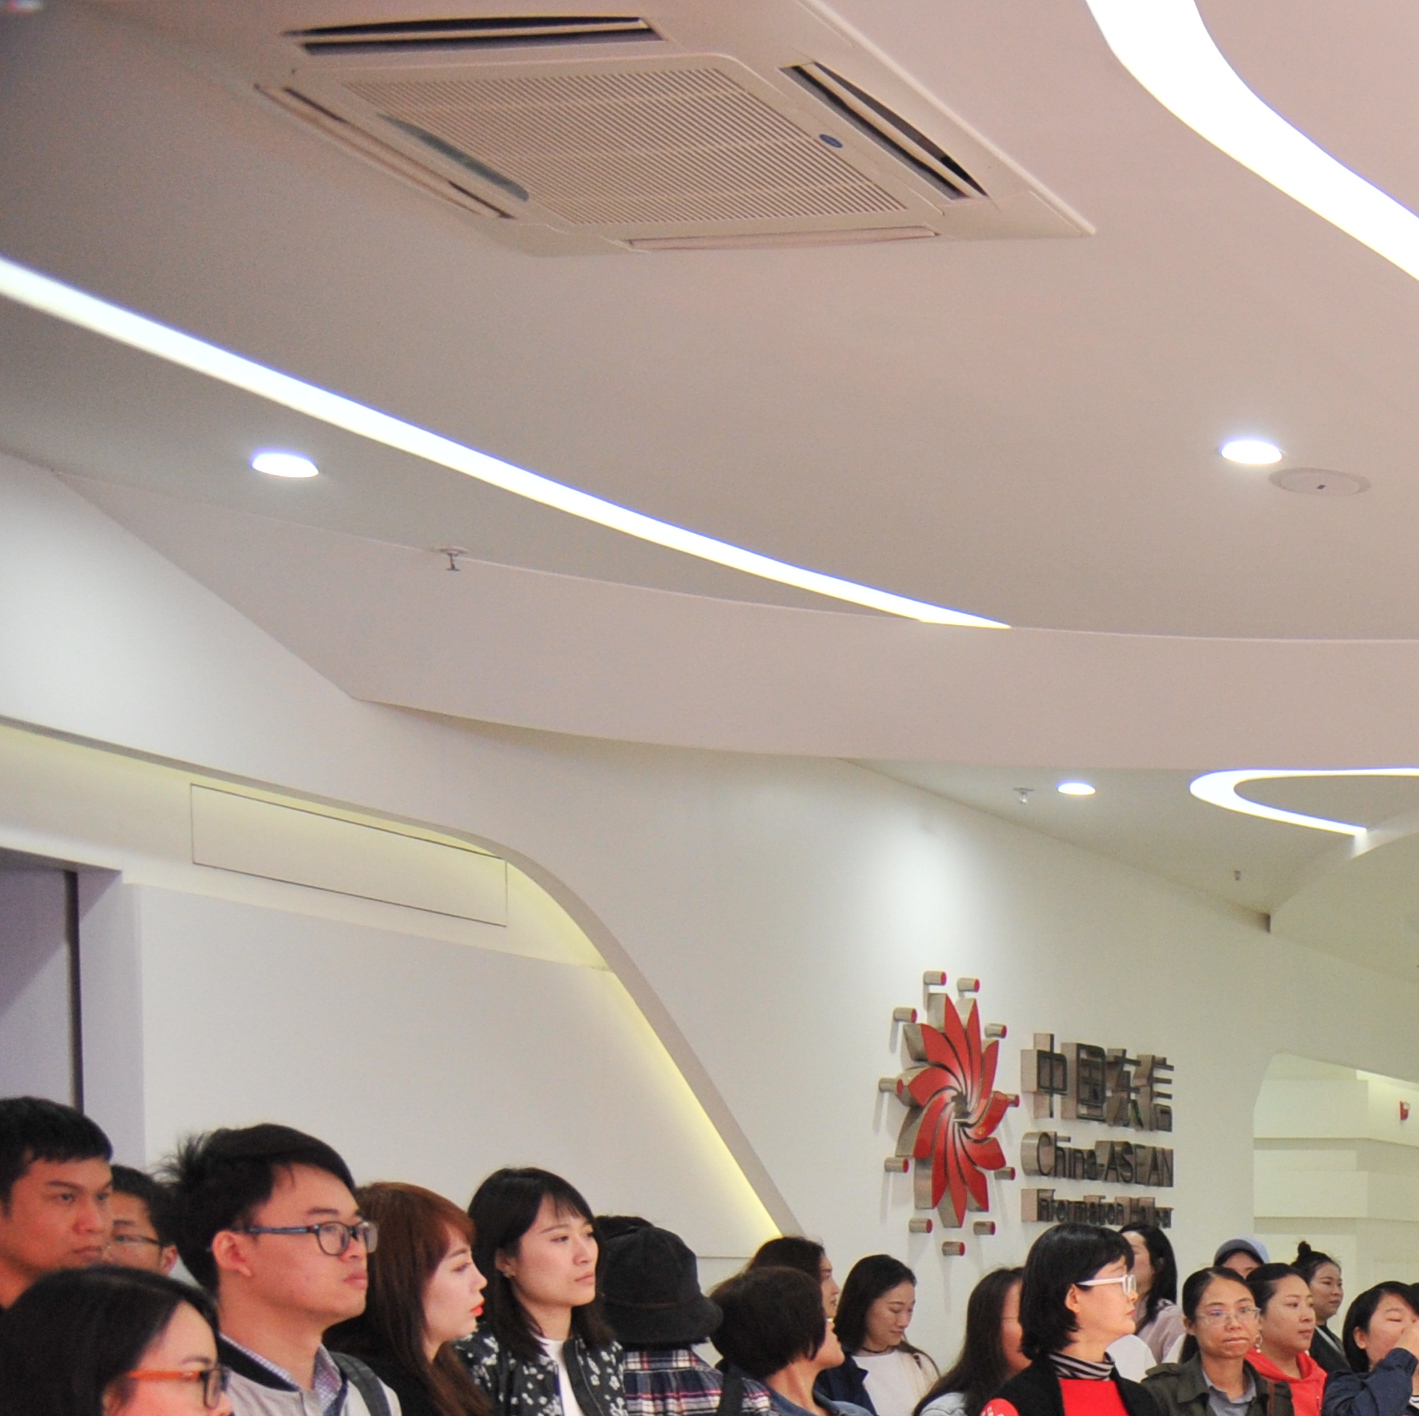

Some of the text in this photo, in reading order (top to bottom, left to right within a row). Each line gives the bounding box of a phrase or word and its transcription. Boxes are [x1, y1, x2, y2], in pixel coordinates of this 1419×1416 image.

[1022, 1033, 1175, 1132] 中国东信
[1021, 1131, 1174, 1188] China-ASEAN
